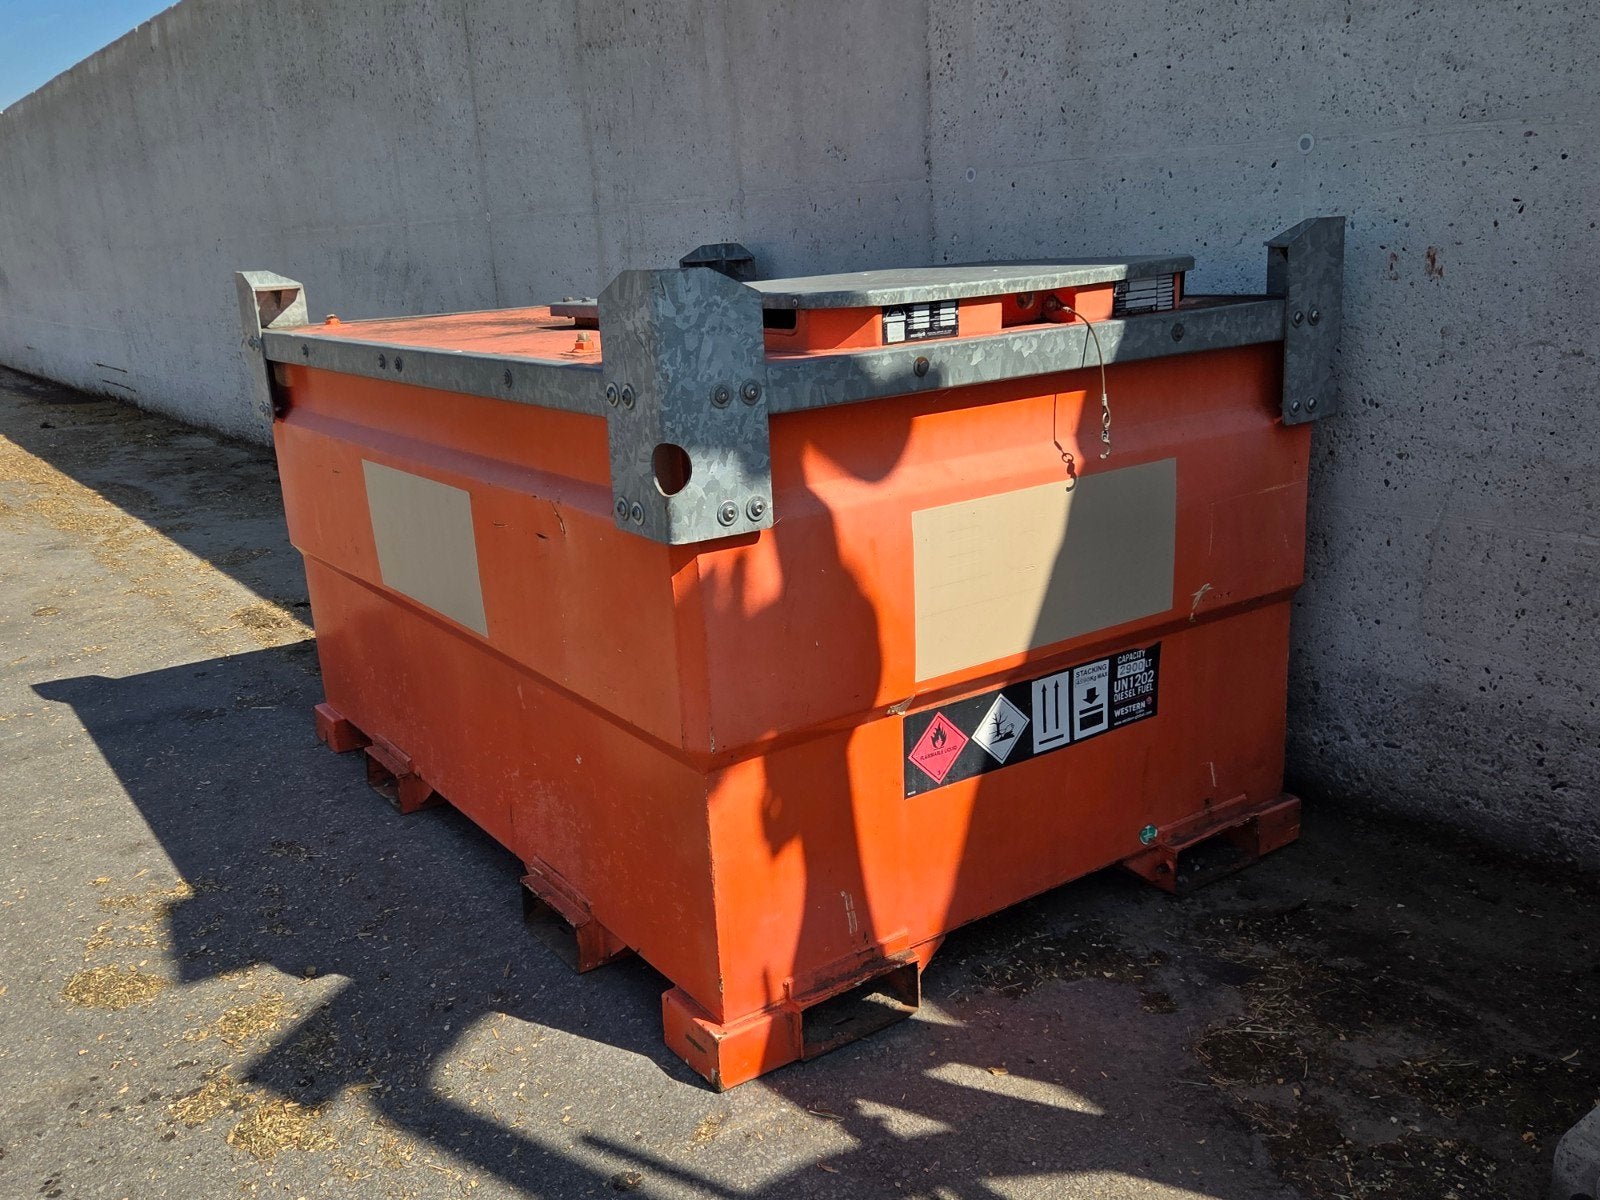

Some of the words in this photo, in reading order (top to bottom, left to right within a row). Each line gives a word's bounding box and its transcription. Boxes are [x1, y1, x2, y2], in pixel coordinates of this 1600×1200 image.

[1117, 650, 1146, 664] CAPACITY
[1076, 663, 1107, 677] STACKING
[1119, 661, 1144, 676] 2900
[1145, 658, 1153, 668] LT
[1113, 670, 1154, 693] UN1202
[1113, 688, 1136, 702] DIESEL
[1137, 683, 1154, 694] FUEL
[1114, 700, 1146, 717] WESTERN
